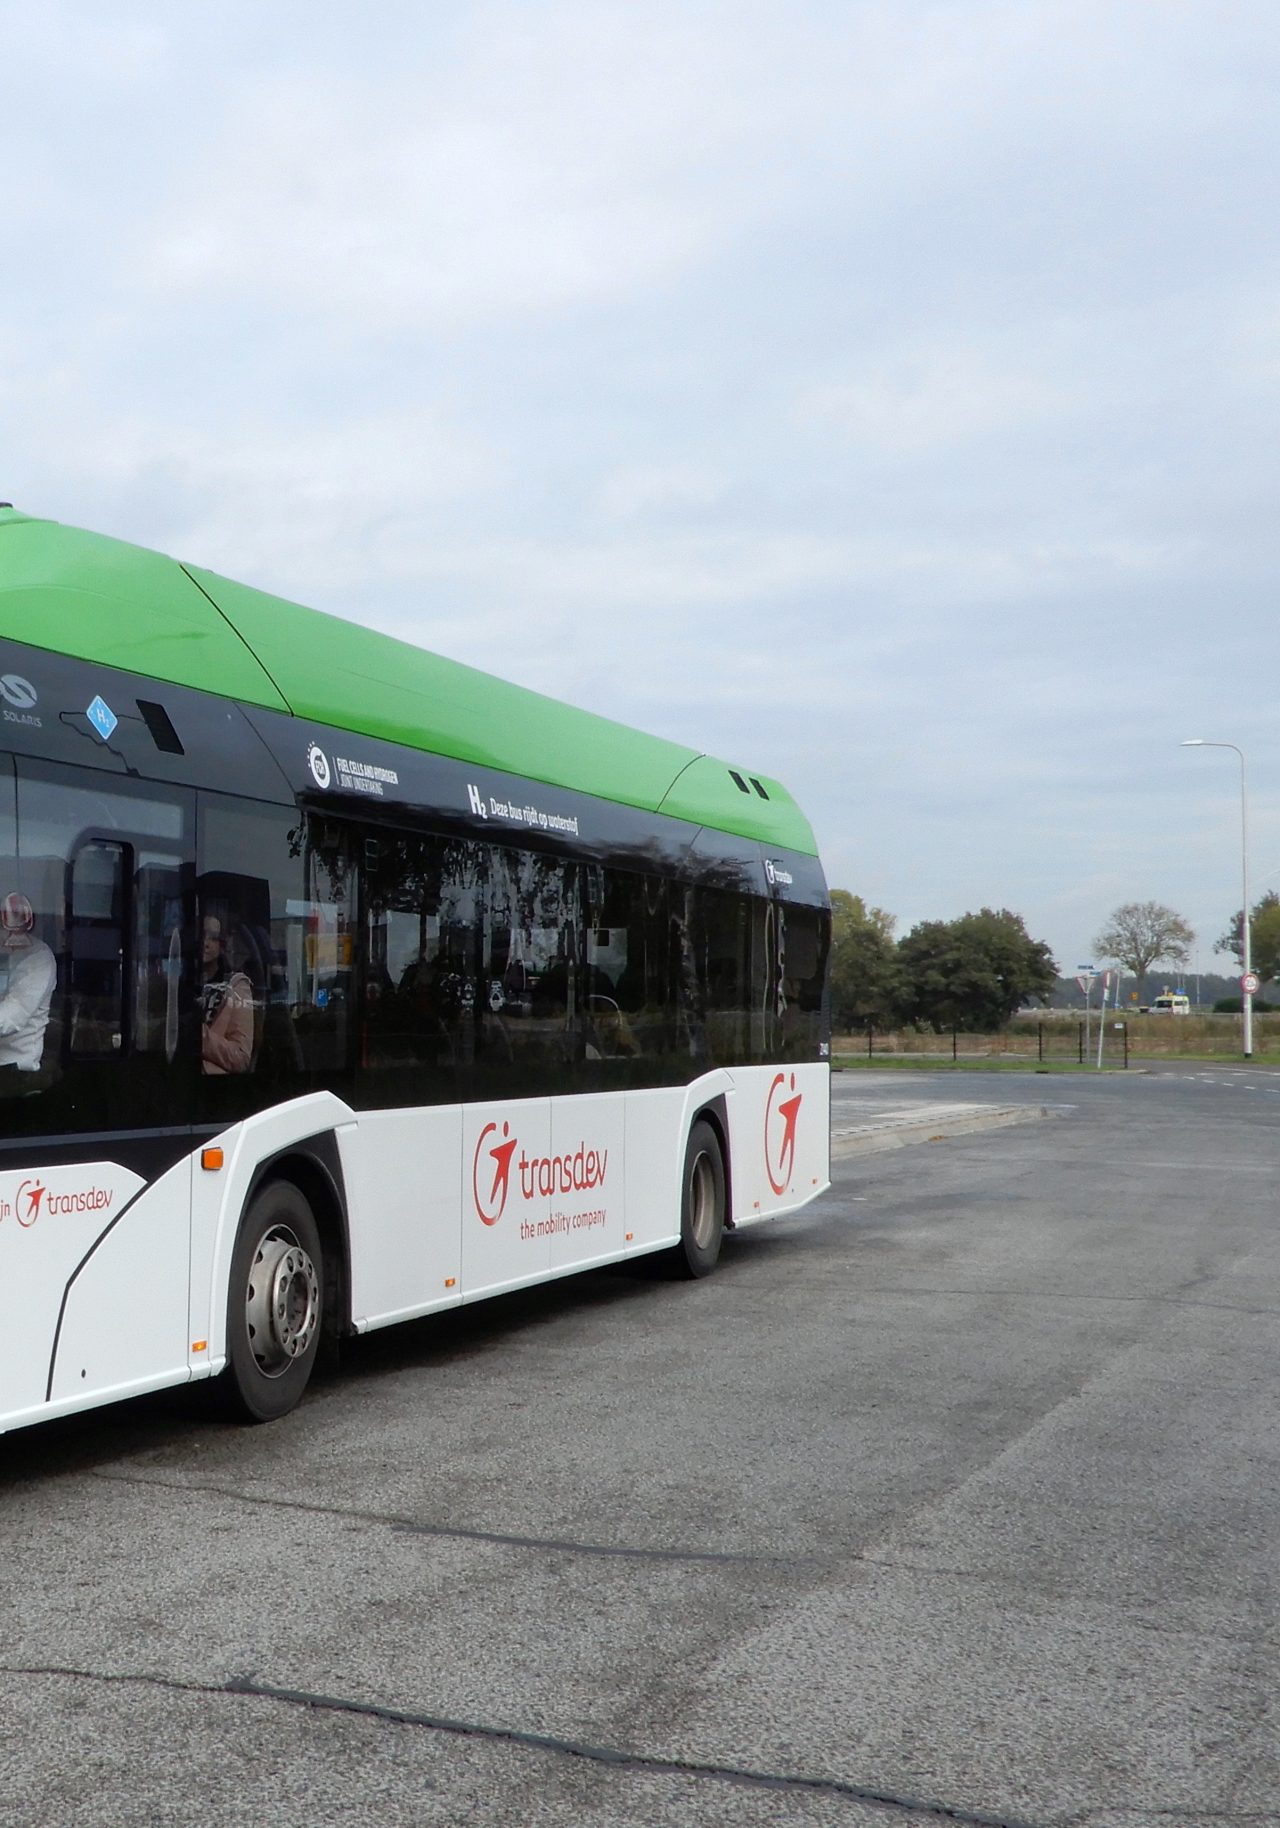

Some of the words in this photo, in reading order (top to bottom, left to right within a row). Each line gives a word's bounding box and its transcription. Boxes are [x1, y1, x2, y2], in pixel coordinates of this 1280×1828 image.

[3, 710, 43, 727] SOLARIS
[337, 757, 350, 773] FUEL
[349, 760, 365, 776] CELLS
[364, 764, 375, 779] AND
[374, 767, 399, 785] HYDROGEN
[489, 797, 509, 817] Deze
[508, 801, 523, 820] bus
[523, 806, 539, 826] rijdt
[539, 813, 548, 829] op
[548, 814, 579, 836] waterstof
[519, 1141, 608, 1200] transdev
[46, 1186, 113, 1215] transdev
[520, 1218, 535, 1240] the
[537, 1211, 570, 1236] mobility
[572, 1208, 607, 1231] company
